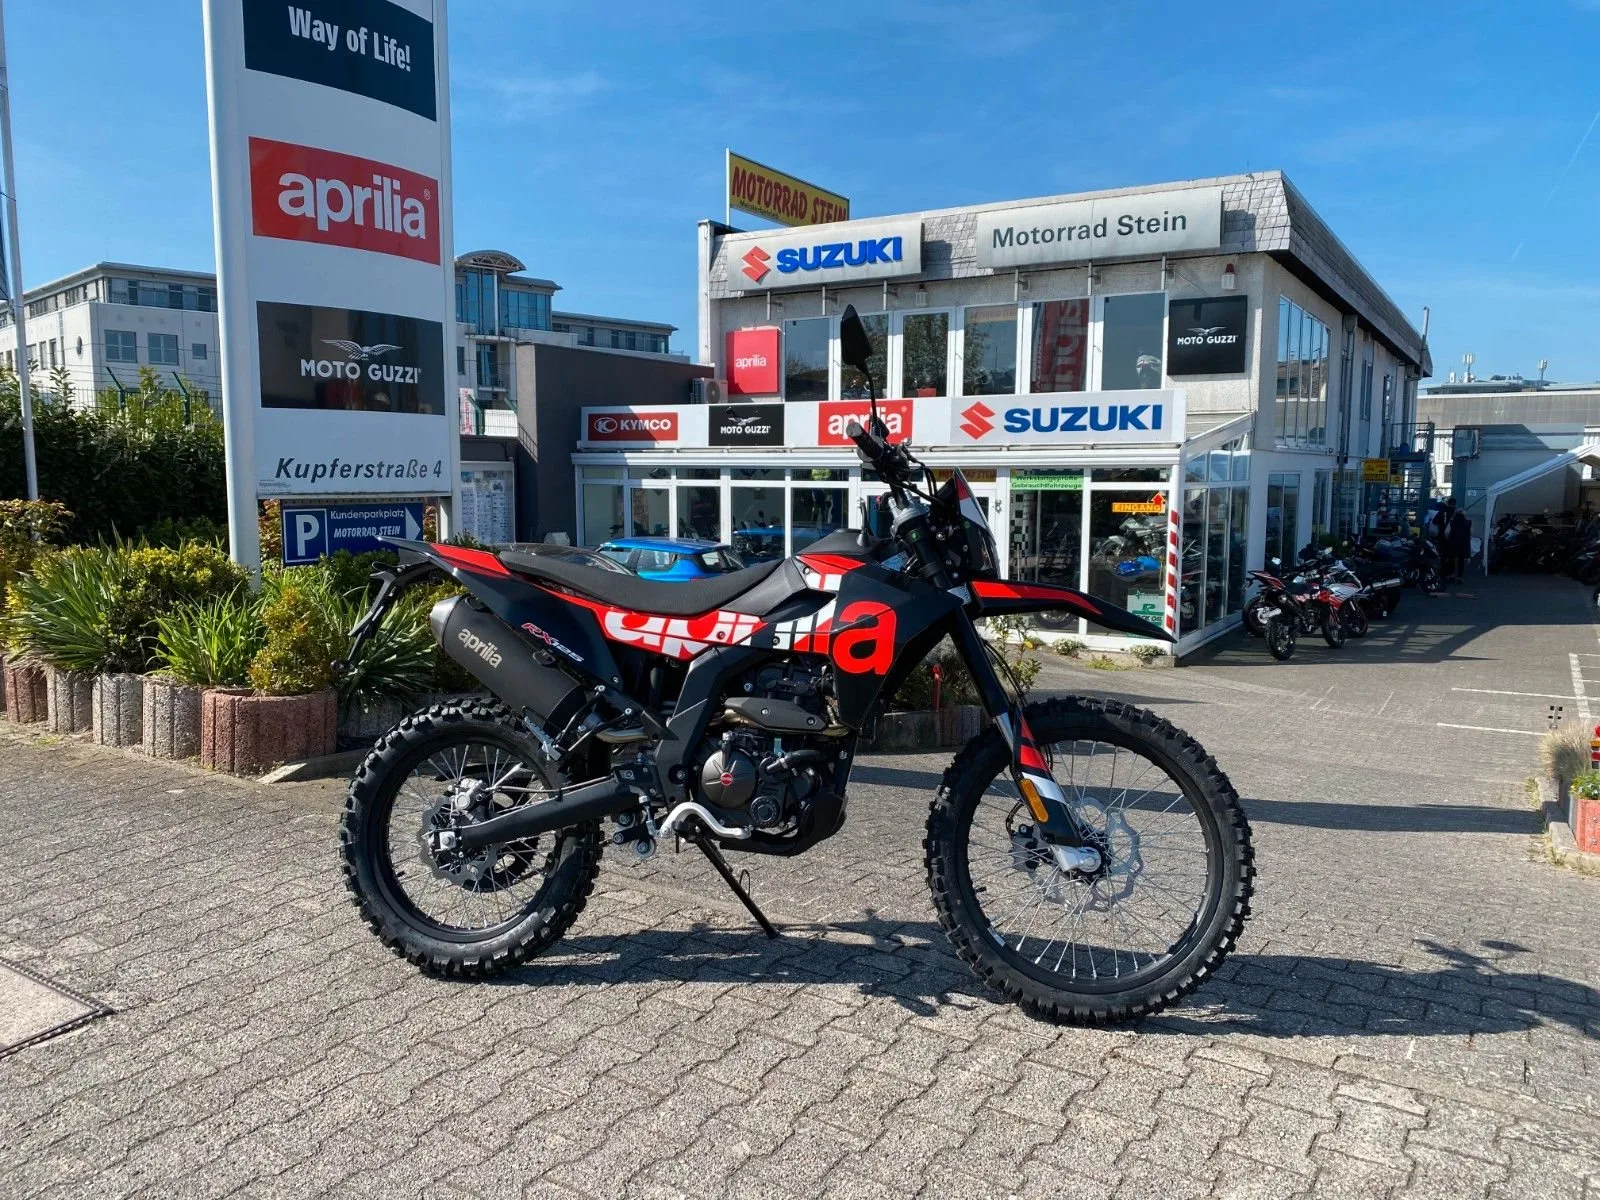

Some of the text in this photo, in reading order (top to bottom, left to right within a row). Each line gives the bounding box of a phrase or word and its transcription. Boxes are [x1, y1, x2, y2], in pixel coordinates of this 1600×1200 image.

[288, 6, 411, 72] Way of Life!
[278, 172, 426, 239] aprilia
[732, 166, 808, 220] MOTORRAD
[993, 210, 1187, 248] Motorrad Stein
[777, 236, 902, 273] SUZUKI
[1177, 334, 1236, 345] MOTO GUZZI
[301, 359, 419, 384] MOTO GUZZI
[735, 354, 767, 369] aprilia
[620, 418, 671, 431] KYMCO
[720, 424, 769, 434] MOTO GUZZI
[1004, 404, 1163, 433] SUZUKI
[275, 458, 442, 483] Kupferstraße 4
[330, 510, 404, 520] Kundenparkplatz
[296, 515, 320, 557] P
[334, 525, 401, 538] MOTORRAD STEIN
[458, 628, 502, 669] aprilia
